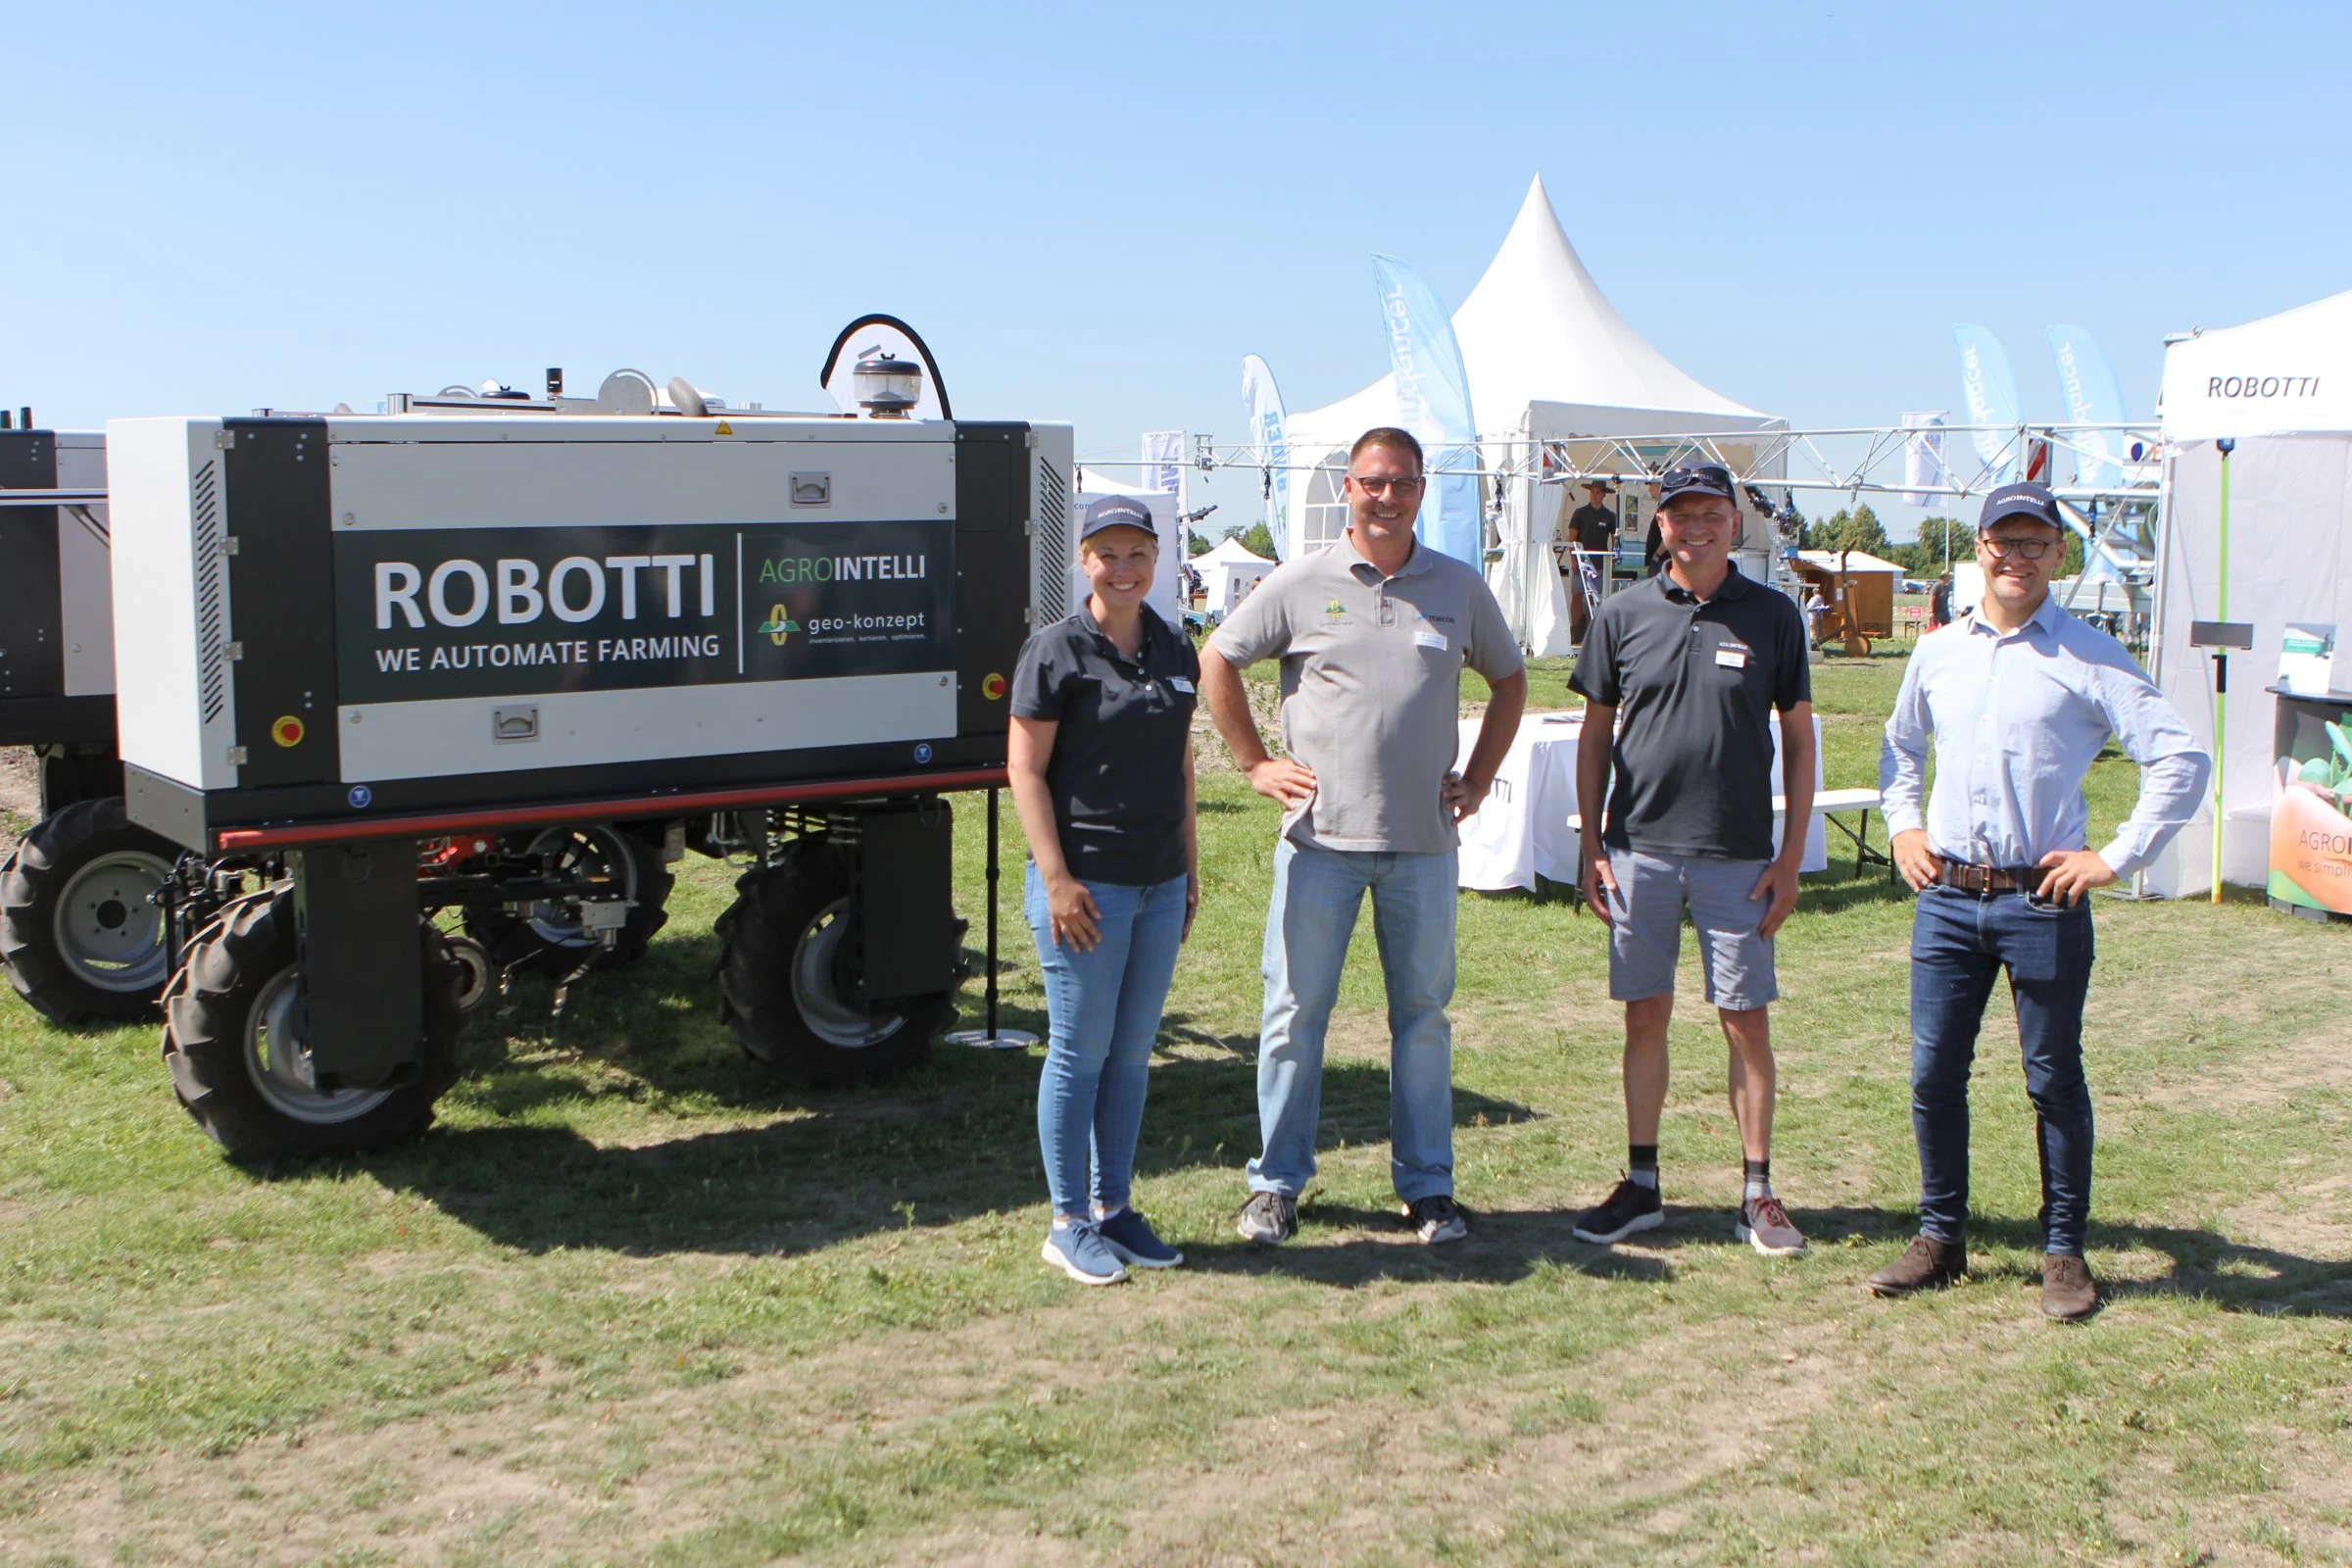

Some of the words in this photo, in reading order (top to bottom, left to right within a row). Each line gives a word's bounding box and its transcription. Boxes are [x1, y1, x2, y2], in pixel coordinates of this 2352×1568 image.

[2208, 376, 2320, 398] ROBOTTI
[1995, 494, 2045, 506] AGROINTELLI
[1098, 507, 1145, 519] AGROINTELLI
[759, 555, 925, 583] AGROINTELLI
[374, 554, 714, 630] ROBOTTI
[808, 612, 925, 635] geo-konzept
[374, 648, 420, 672] WE
[429, 641, 588, 670] AUTOMATE
[598, 635, 720, 662] FARMING
[2298, 859, 2312, 871] we
[2314, 860, 2352, 879] simpli
